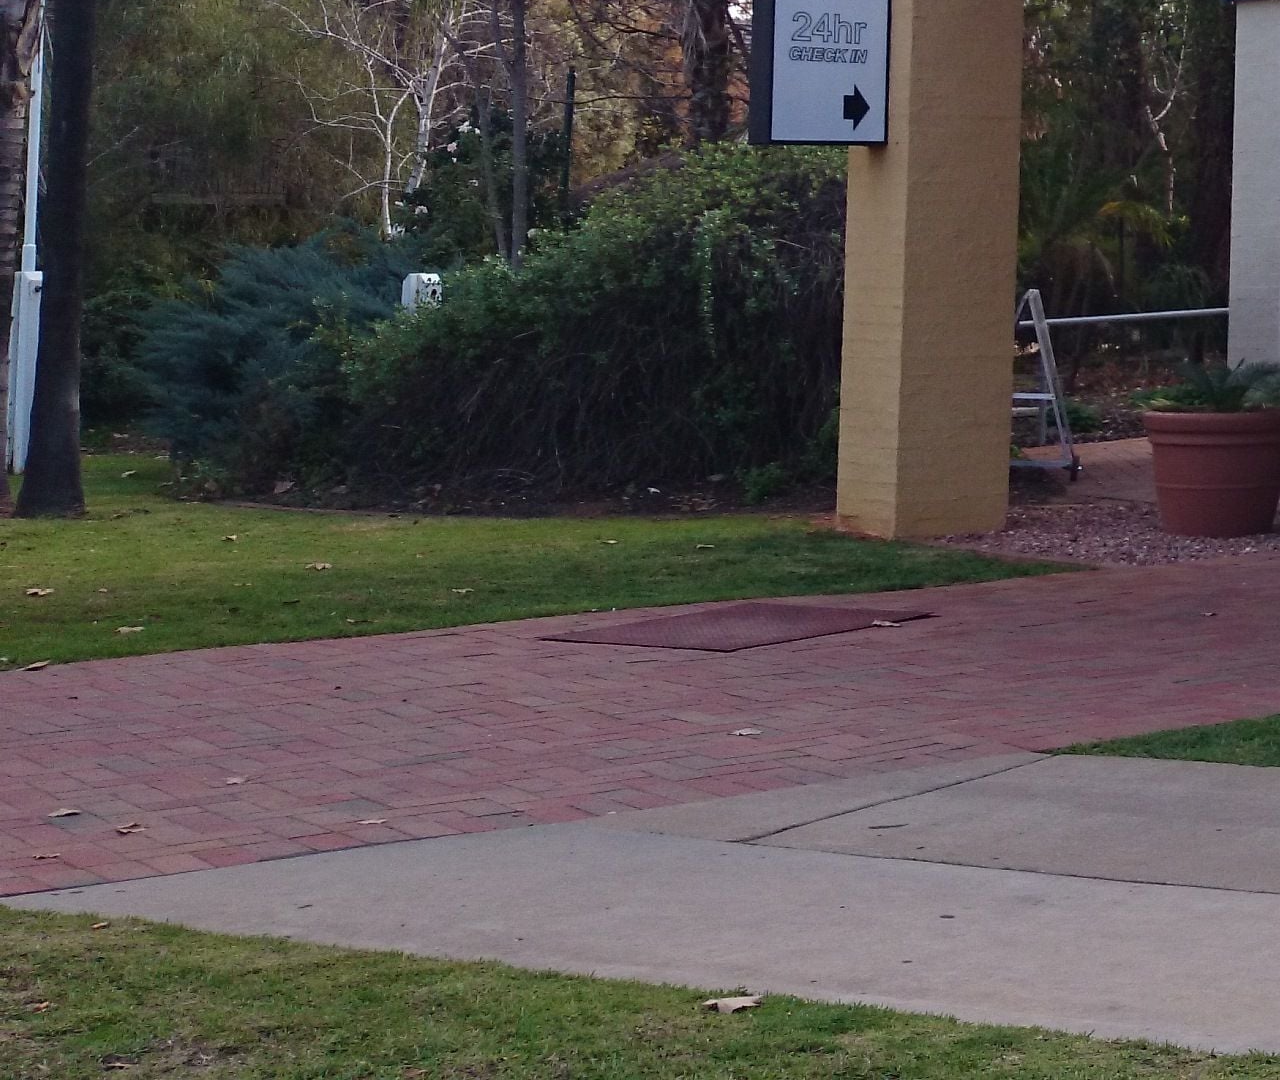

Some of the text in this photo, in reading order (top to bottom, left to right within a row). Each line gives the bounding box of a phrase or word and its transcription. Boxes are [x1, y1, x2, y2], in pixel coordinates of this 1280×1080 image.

[790, 10, 868, 45] 24hr
[788, 45, 868, 64] CHECK IN
